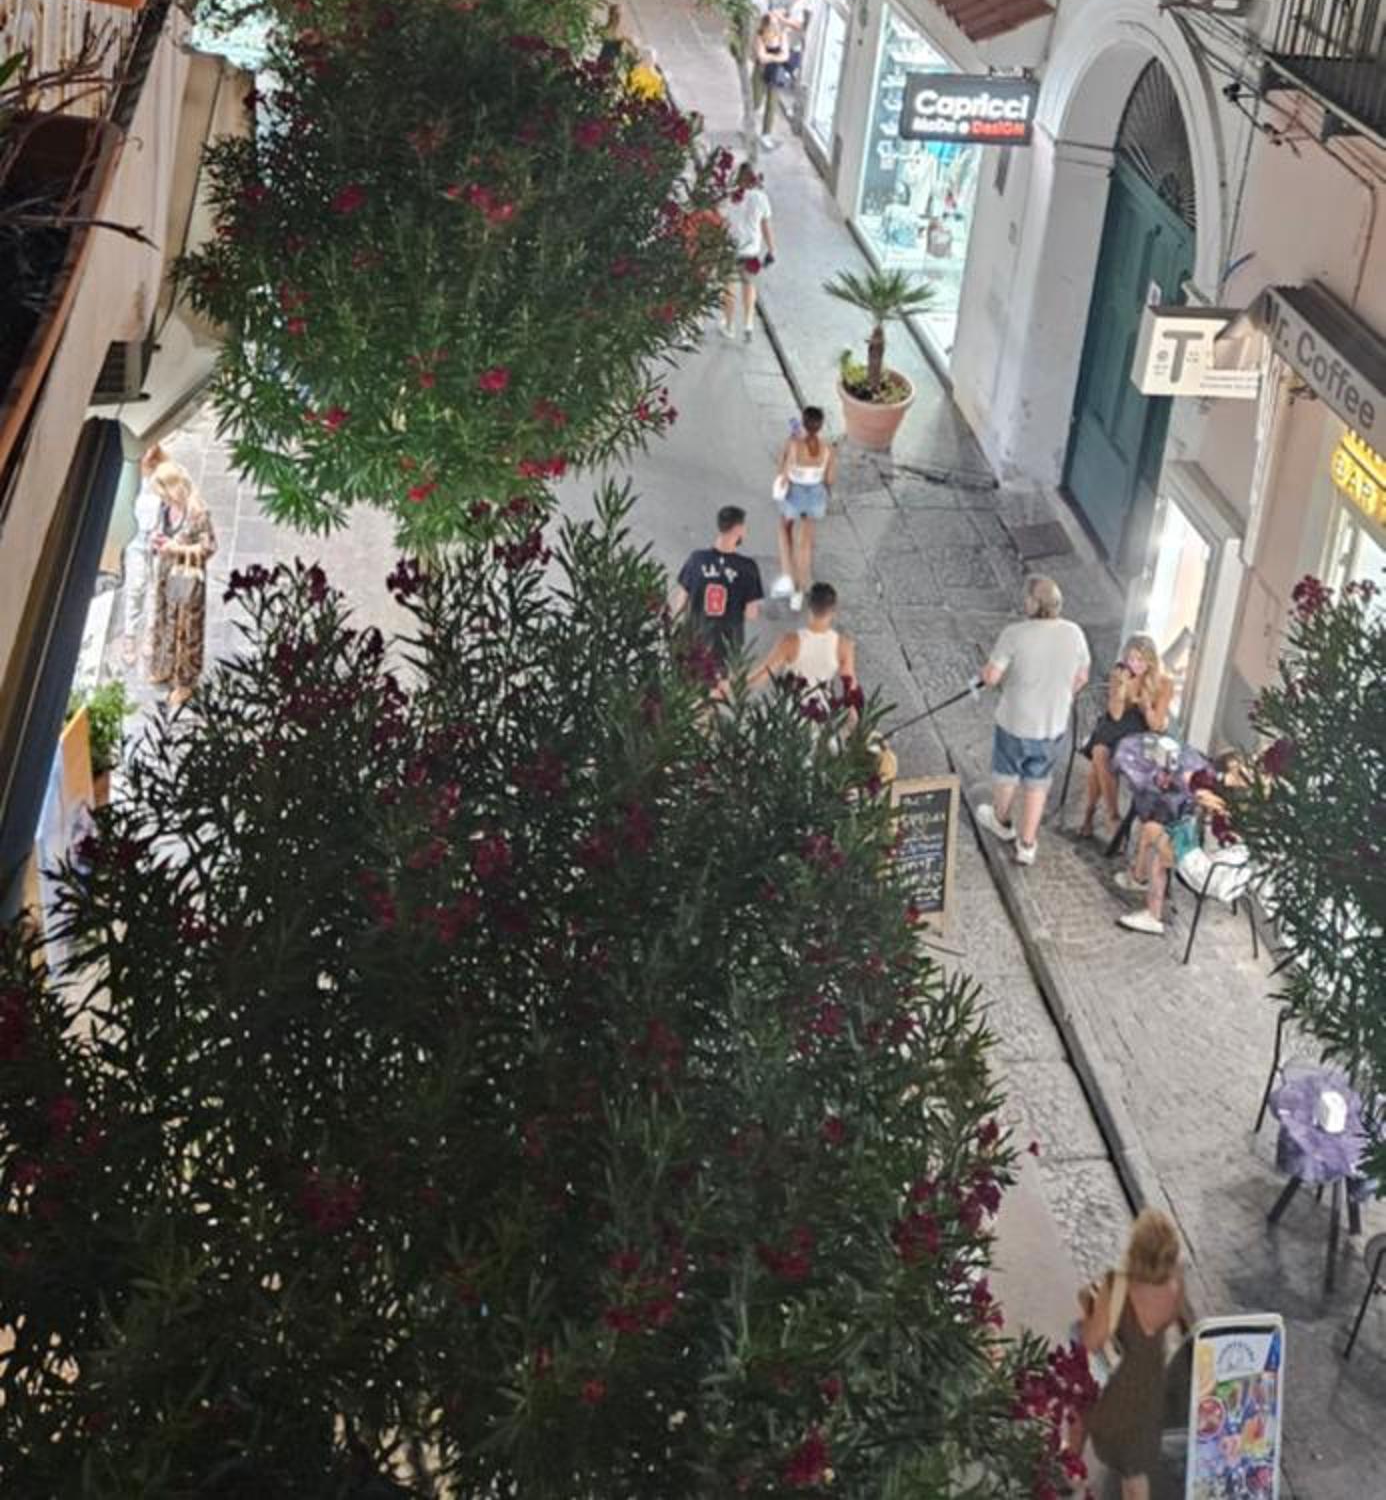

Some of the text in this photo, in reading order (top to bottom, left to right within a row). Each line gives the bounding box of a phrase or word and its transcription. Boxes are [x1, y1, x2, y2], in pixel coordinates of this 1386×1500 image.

[914, 89, 1030, 120] Capricci
[1161, 329, 1204, 384] T
[1297, 330, 1375, 430] Coffee
